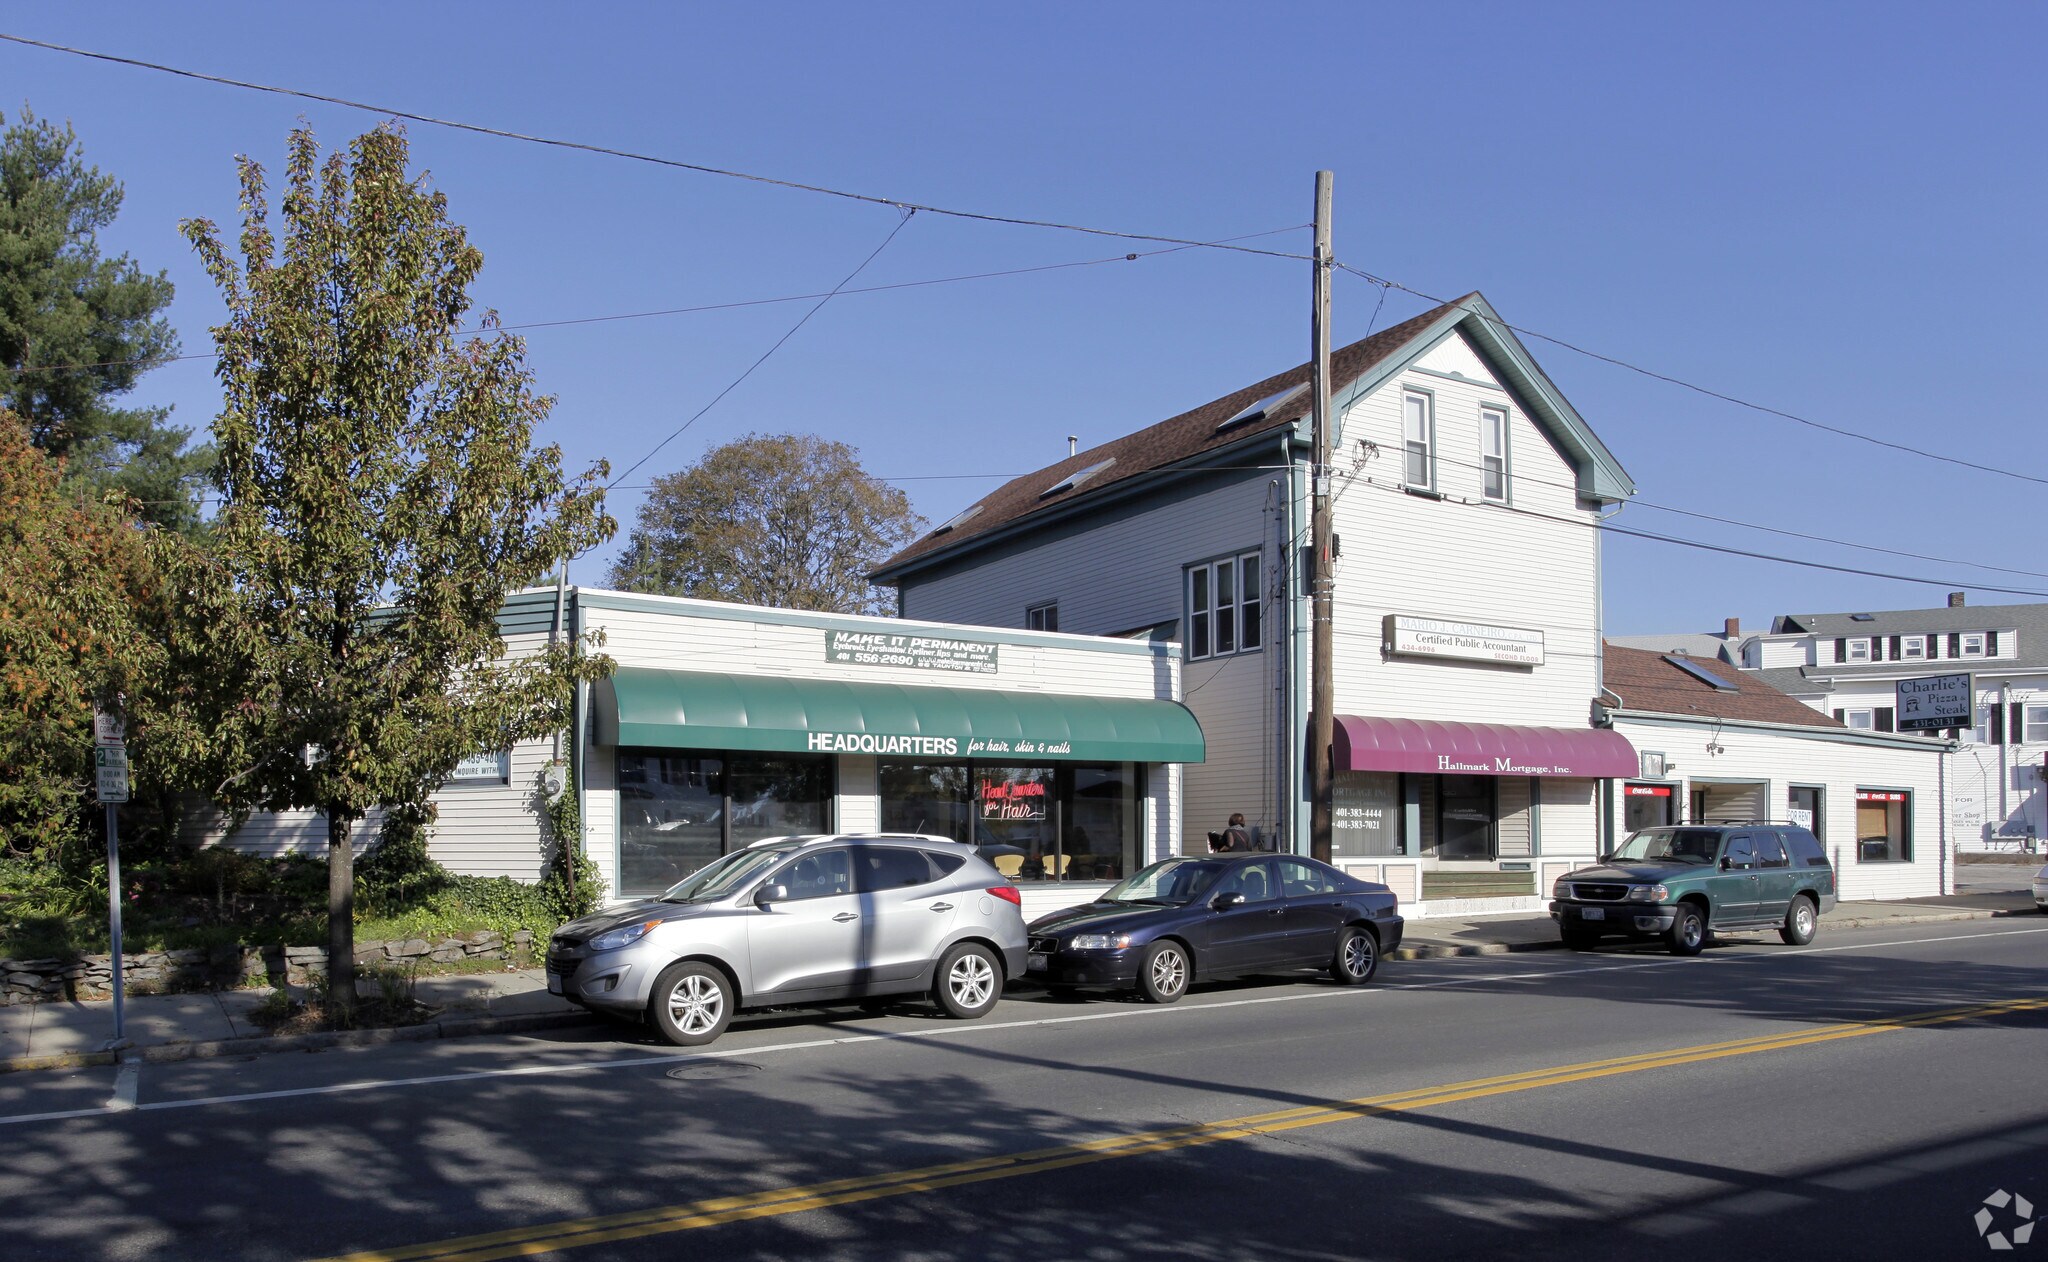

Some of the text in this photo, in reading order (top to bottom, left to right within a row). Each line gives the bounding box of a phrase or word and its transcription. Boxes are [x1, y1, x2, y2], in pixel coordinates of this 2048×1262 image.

[1401, 618, 1437, 631] MARIO
[1440, 622, 1449, 632] J.
[834, 632, 996, 653] MAKE IT PERMANENT
[1415, 633, 1526, 653] Certified Public Accountant
[1401, 644, 1436, 653] 434-6996
[836, 652, 914, 666] 401 556-2690
[953, 651, 968, 659] and
[1494, 652, 1539, 663] SECOND FLOOR
[1900, 678, 1967, 693] Charlie's
[1928, 693, 1958, 704] Pizza
[1934, 704, 1967, 715] Steak
[1912, 718, 1955, 728] 431-0131
[808, 732, 1071, 755] HEADQUARTERS for hair, skin & nails
[97, 750, 105, 764] 2
[1438, 755, 1572, 774] Hallmark Mortgage, Inc.
[1332, 788, 1373, 798] ORTGAGE
[1001, 799, 1043, 819] Hair
[1336, 808, 1382, 818] 401-383-4444
[1798, 810, 1811, 822] RENT
[1964, 811, 1981, 819] Shop
[1336, 820, 1380, 829] 401-383-7021
